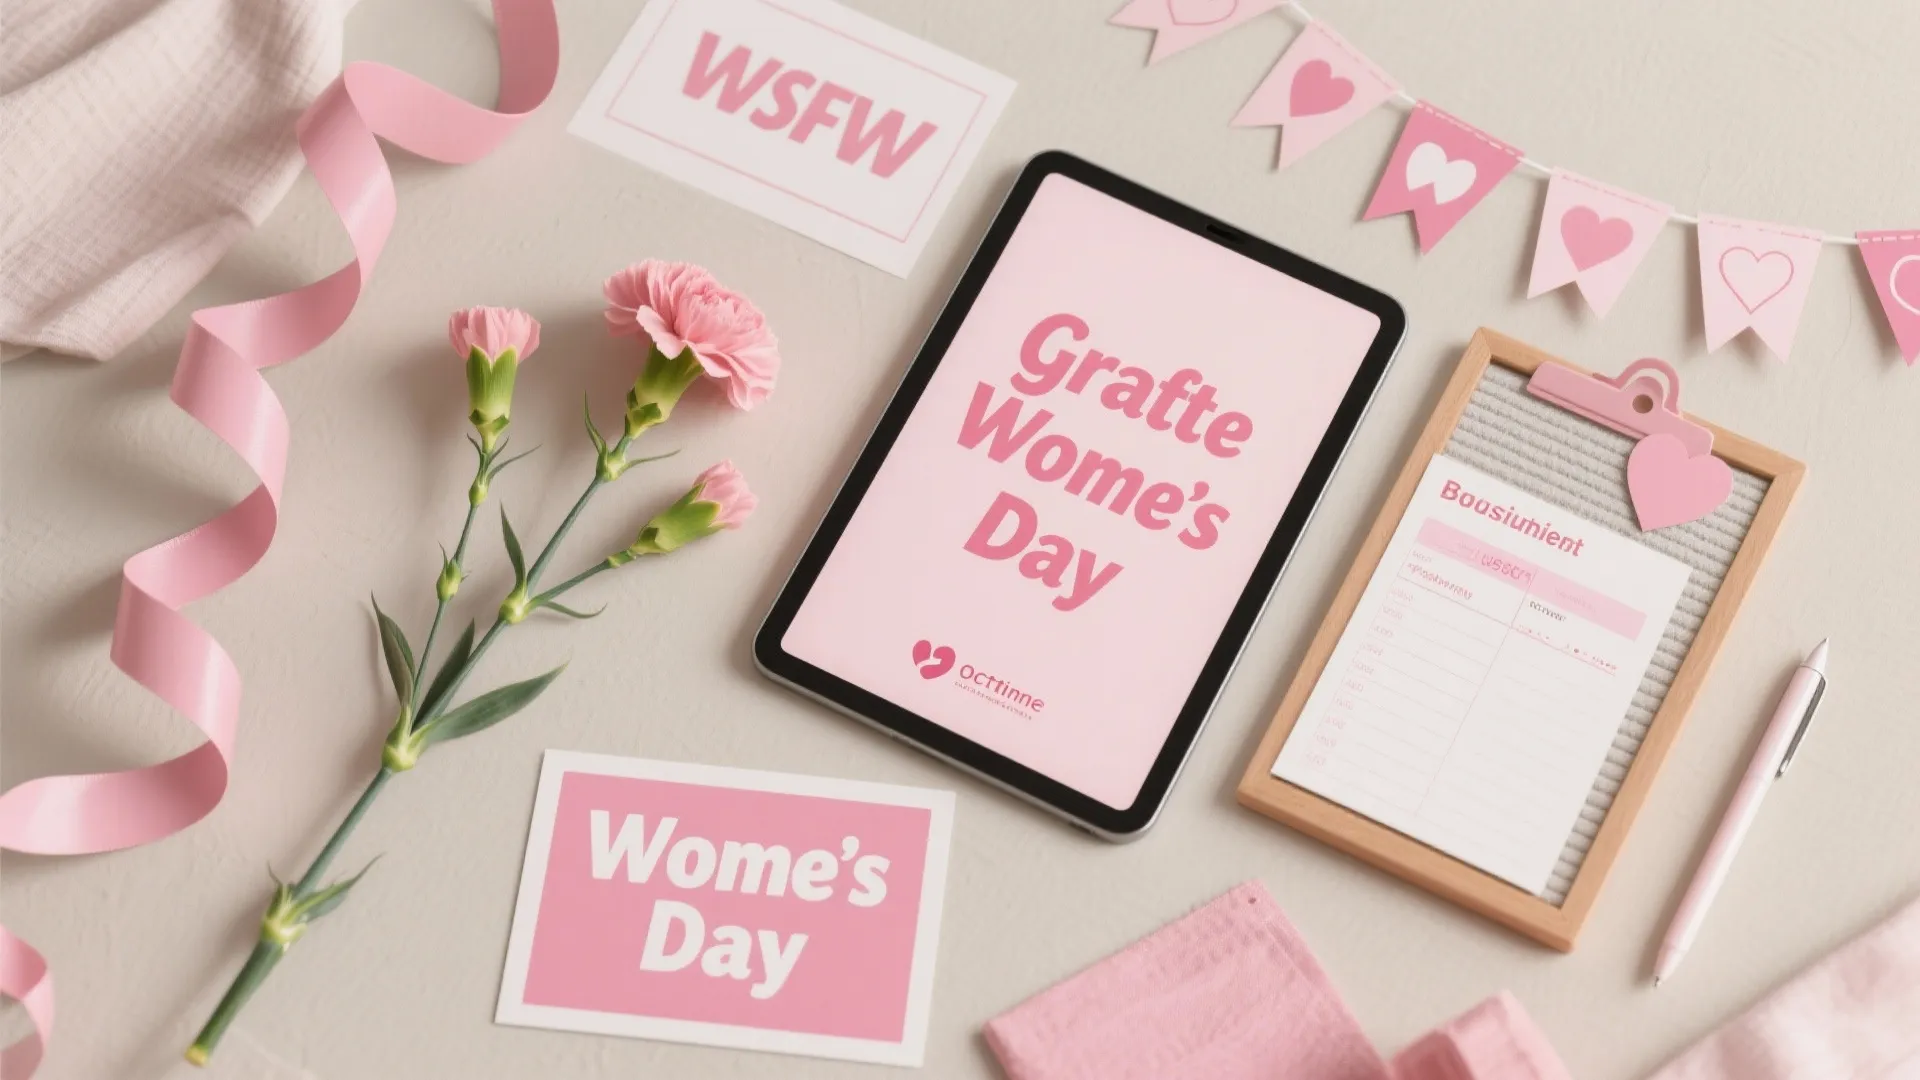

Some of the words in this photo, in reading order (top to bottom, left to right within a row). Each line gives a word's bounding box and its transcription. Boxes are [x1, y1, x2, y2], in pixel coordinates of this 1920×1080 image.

[683, 32, 937, 178] WSFW
[1011, 314, 1254, 459] Grafte
[963, 491, 1124, 612] Day
[639, 899, 809, 1000] Day
